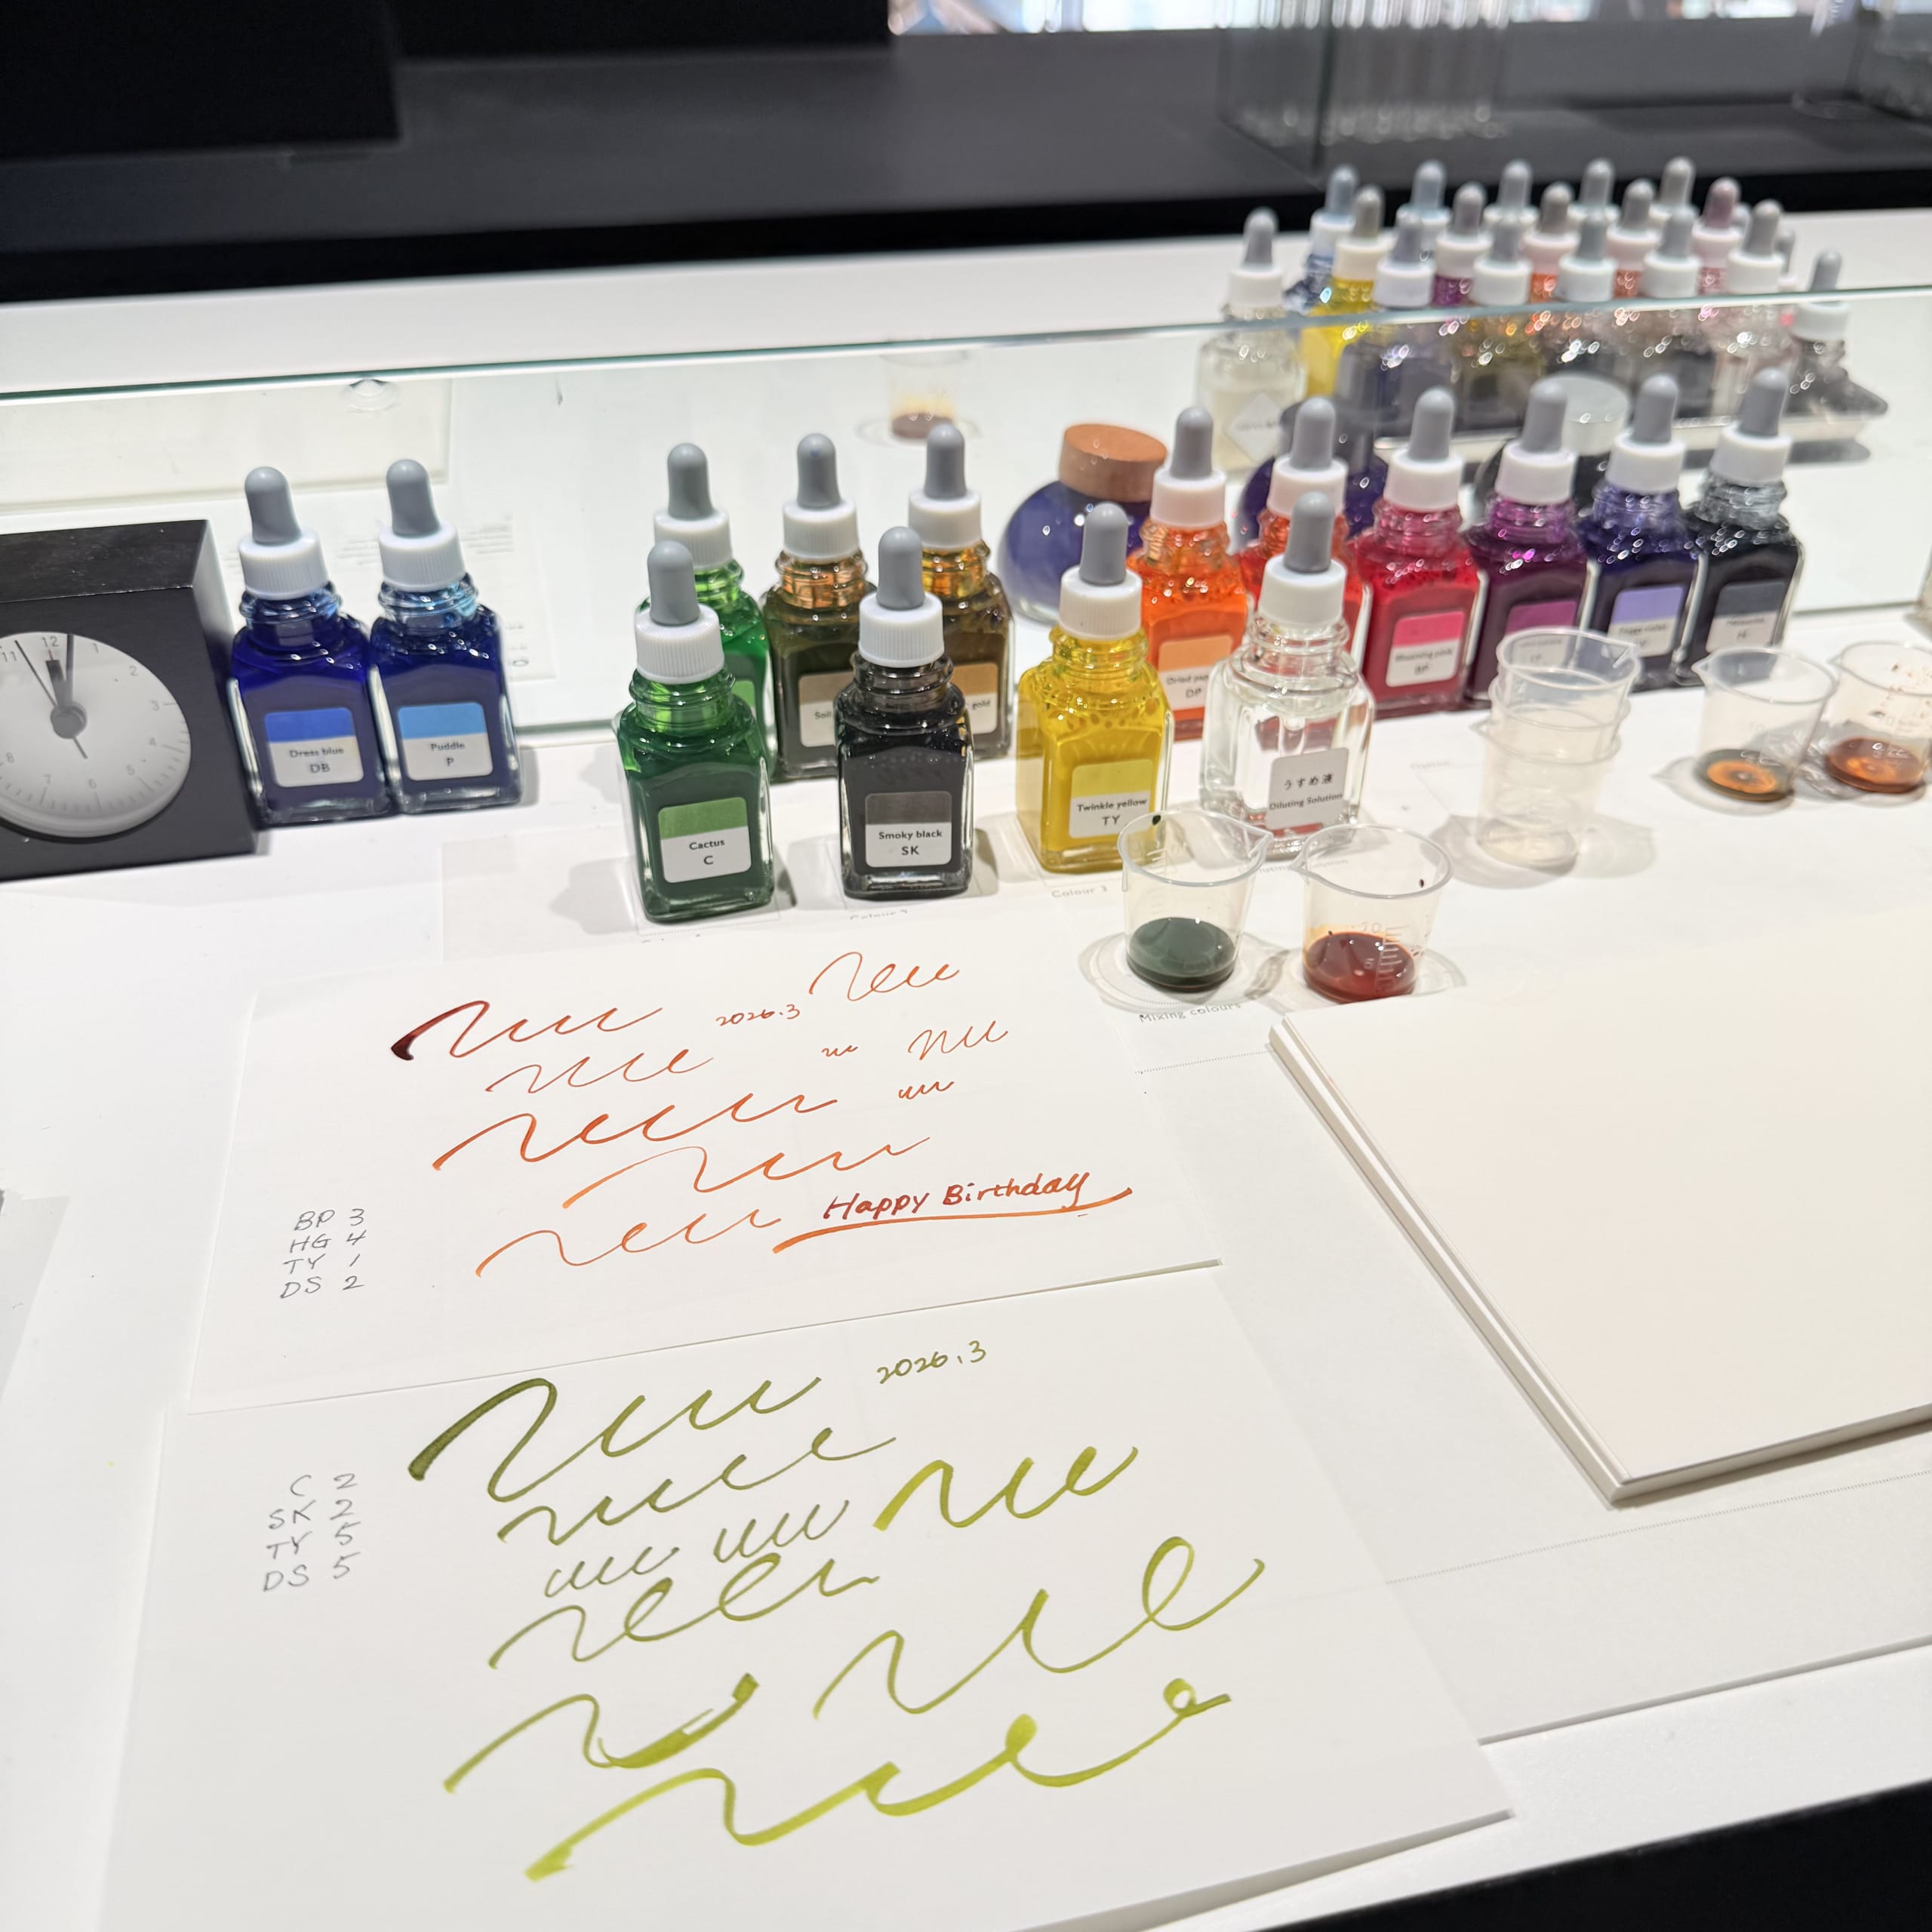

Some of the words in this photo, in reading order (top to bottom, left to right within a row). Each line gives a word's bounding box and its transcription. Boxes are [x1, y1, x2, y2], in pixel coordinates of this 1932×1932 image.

[42, 636, 60, 647] 12
[92, 642, 100, 653] 1
[2, 651, 17, 662] 11
[128, 666, 139, 676] 2
[151, 700, 160, 711] 3
[149, 737, 157, 746] 4
[431, 741, 466, 751] Puddle
[5, 752, 15, 763] 8
[290, 748, 319, 758] Dress
[321, 746, 345, 755] blue
[310, 762, 331, 774] DB
[446, 757, 454, 767] P
[126, 764, 135, 776] 5
[43, 774, 51, 785] 7
[1077, 801, 1114, 812] Twinkle
[1117, 798, 1147, 811] yellow
[1269, 799, 1304, 811] Diluting
[1306, 793, 1343, 805] Solution
[1102, 814, 1121, 826] TY
[878, 831, 914, 841] Smoky
[916, 829, 943, 838] black
[689, 839, 725, 851] Cactus
[901, 845, 920, 856] SK
[703, 855, 714, 866] C
[1051, 888, 1095, 898] Colour
[1140, 1011, 1186, 1023] Mixing
[1190, 1002, 1241, 1016] colours
[823, 1192, 930, 1220] Happy
[942, 1172, 1091, 1211] Birthday
[294, 1209, 335, 1231] BP
[349, 1208, 365, 1226] 3
[290, 1232, 332, 1254] HG
[346, 1229, 368, 1246] 4
[283, 1253, 326, 1275] TY
[279, 1275, 322, 1299] DS
[342, 1275, 365, 1291] 2
[290, 1474, 312, 1497] C
[333, 1472, 358, 1491] 2
[268, 1499, 317, 1530] SK
[330, 1498, 355, 1521] 2
[266, 1530, 313, 1560] TY
[334, 1521, 361, 1546] 5
[263, 1563, 309, 1592] DS
[333, 1551, 361, 1580] 5
